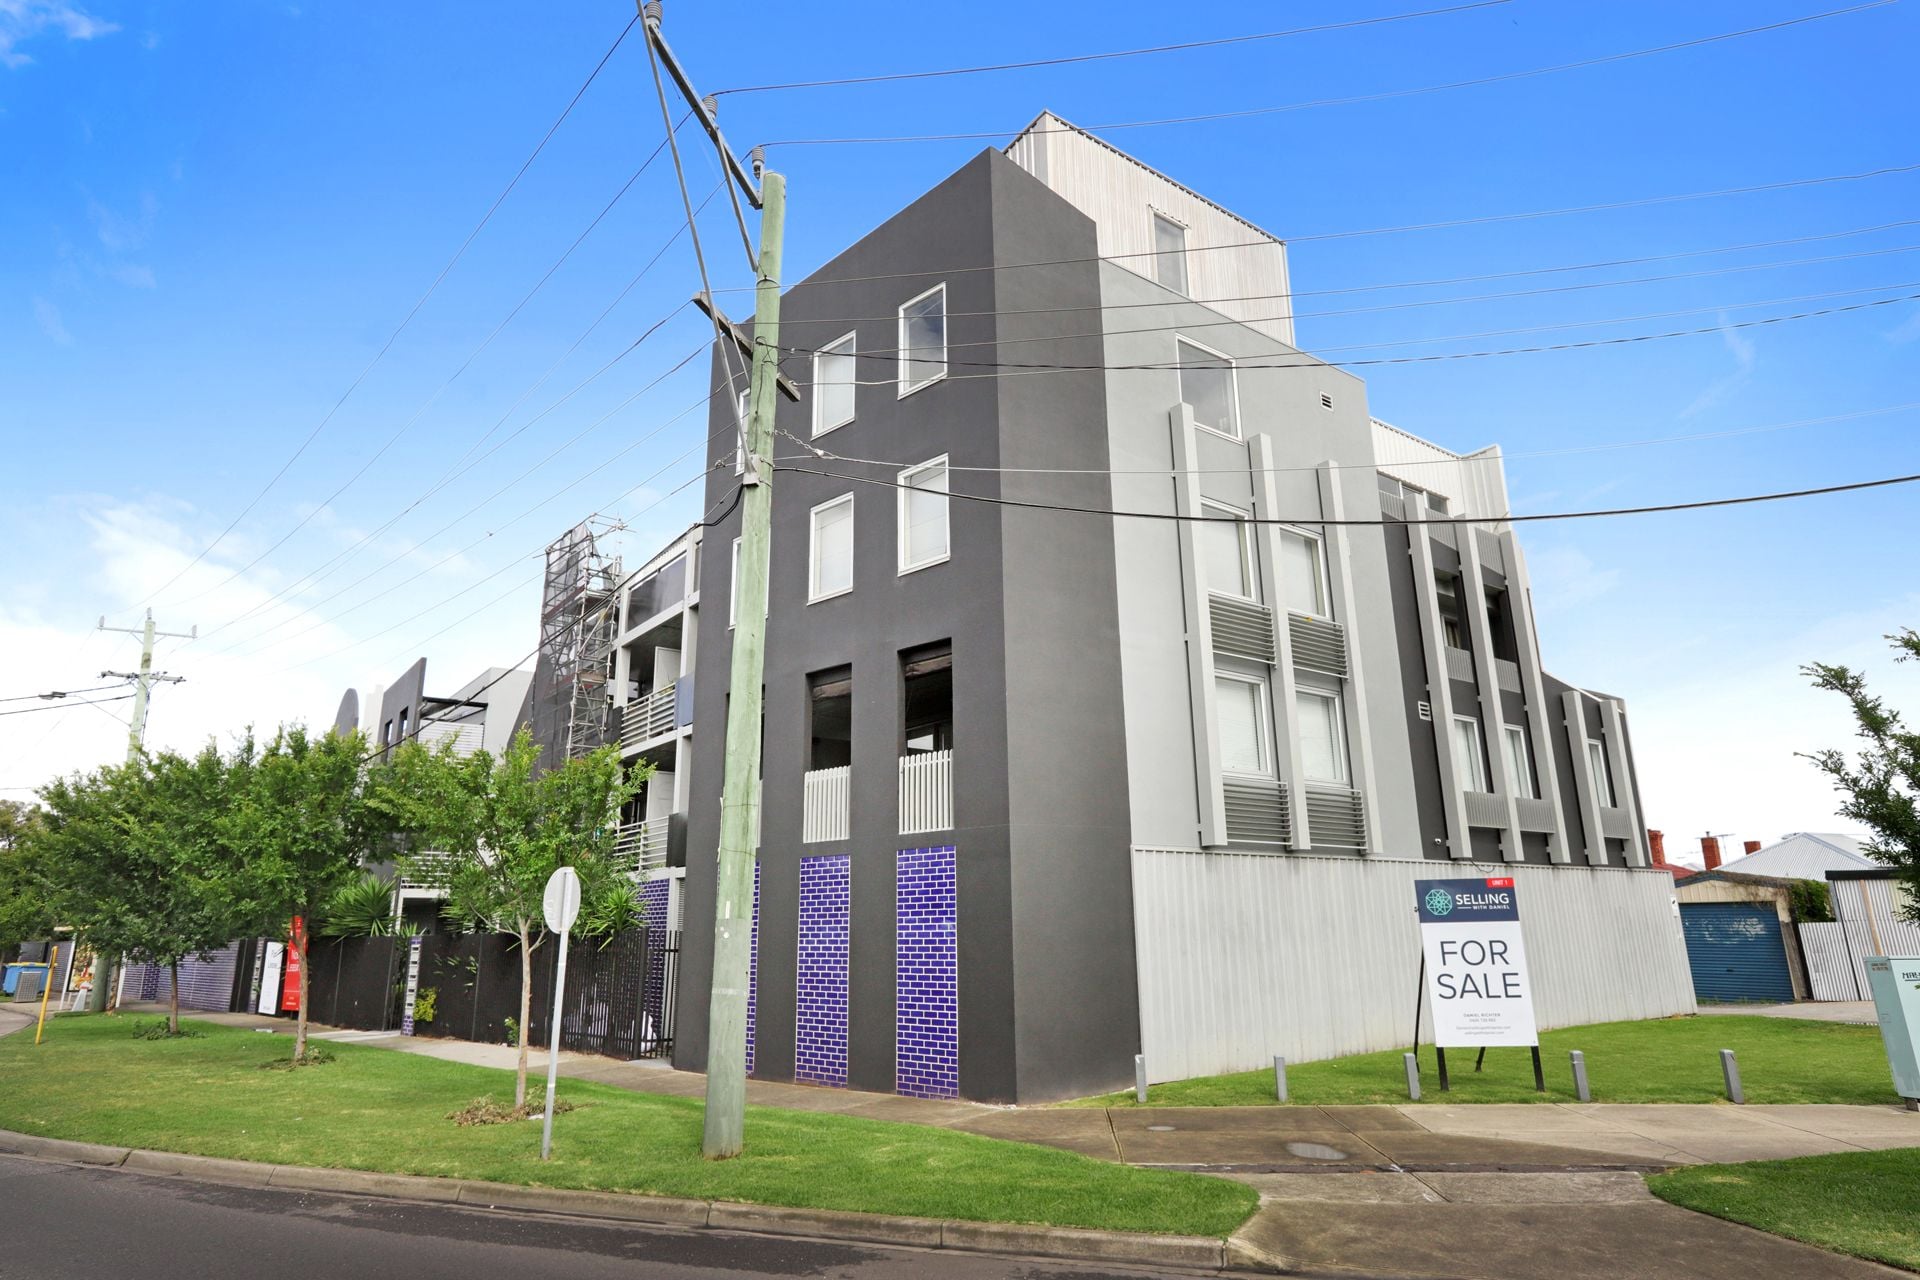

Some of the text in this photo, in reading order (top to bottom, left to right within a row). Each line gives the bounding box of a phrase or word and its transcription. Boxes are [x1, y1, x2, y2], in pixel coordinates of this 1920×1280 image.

[1455, 893, 1510, 905] SELLING
[1440, 940, 1510, 966] FOR
[1437, 972, 1522, 999] SALE
